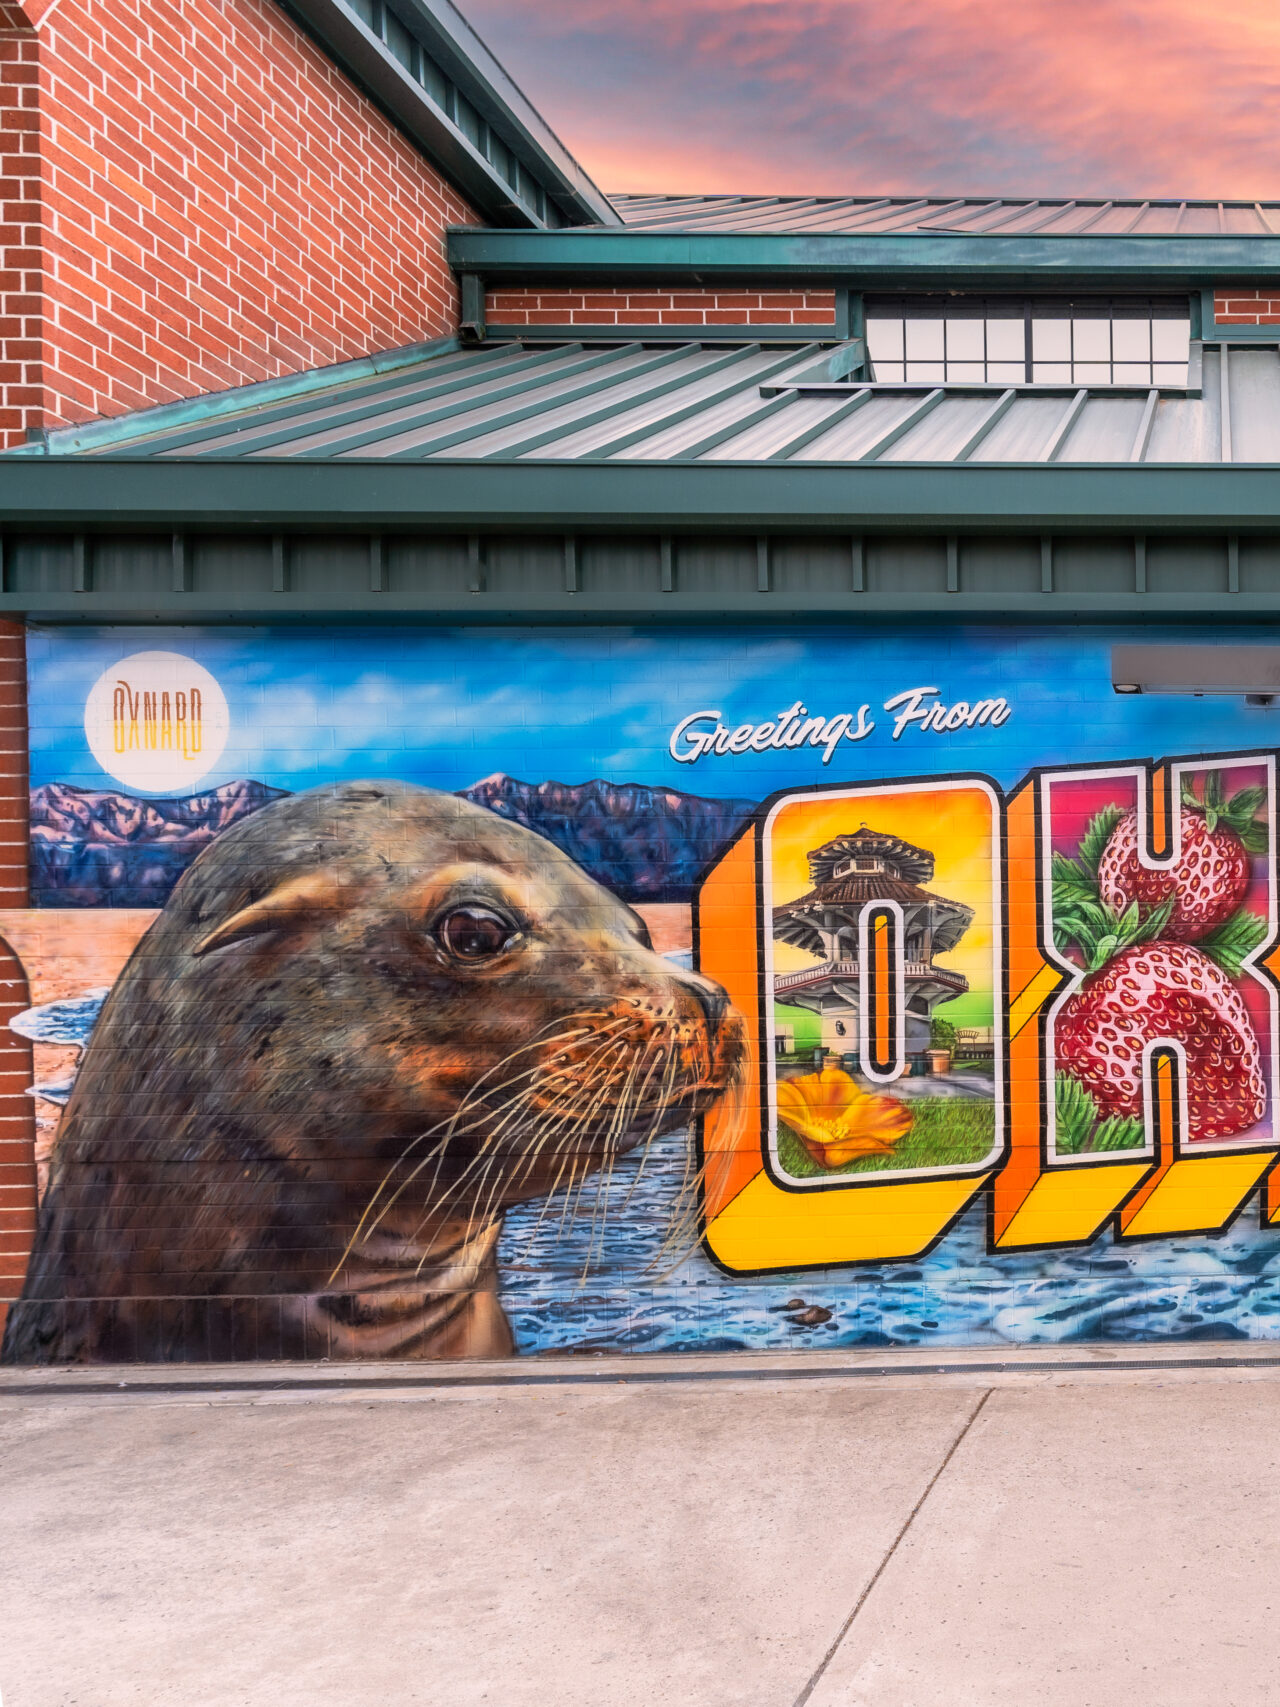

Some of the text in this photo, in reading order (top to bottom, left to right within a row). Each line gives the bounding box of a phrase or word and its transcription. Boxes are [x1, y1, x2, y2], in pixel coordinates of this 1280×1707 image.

[113, 680, 202, 760] OXNARD
[669, 686, 1013, 766] Greetings From
